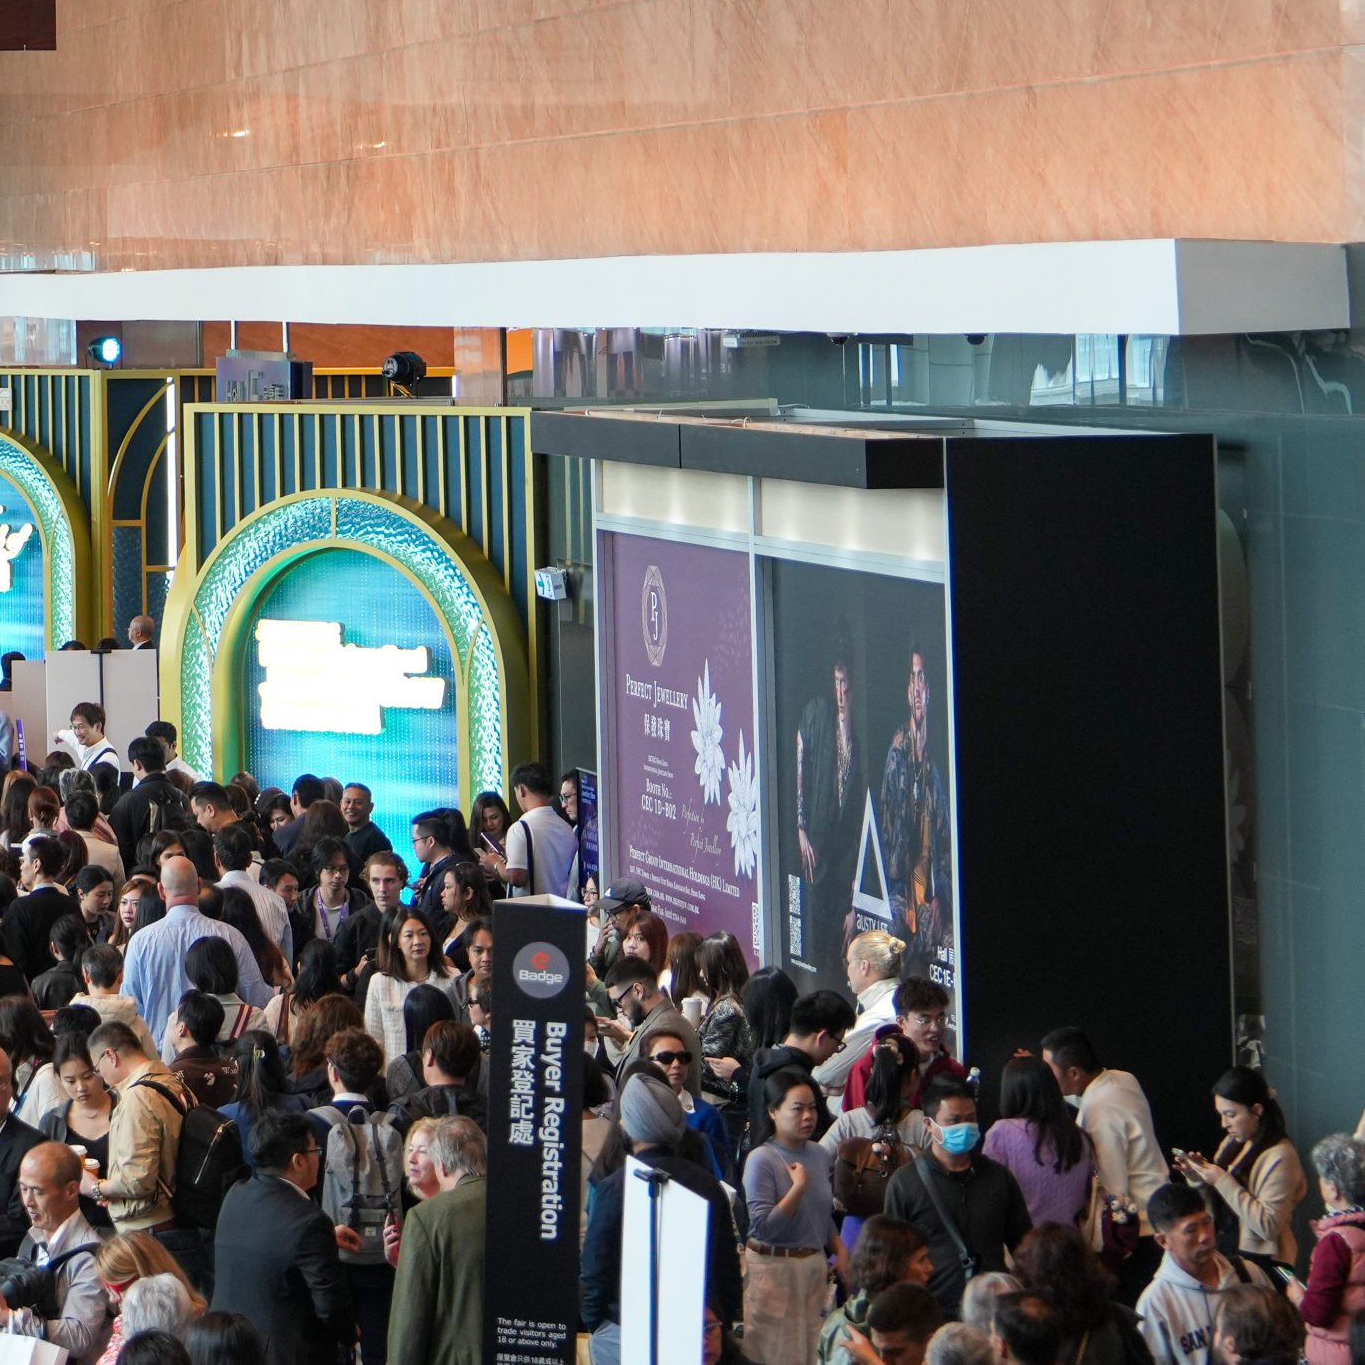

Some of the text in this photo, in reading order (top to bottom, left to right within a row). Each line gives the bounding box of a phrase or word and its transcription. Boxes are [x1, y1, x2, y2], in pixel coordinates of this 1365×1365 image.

[641, 794, 677, 820] CEC 1D-B02
[519, 969, 563, 984] Badge
[509, 1019, 537, 1147] 買家登記處
[541, 1021, 567, 1240] Buyer Registration
[497, 1317, 512, 1326] The
[514, 1318, 527, 1327] fair
[497, 1326, 566, 1340] trade visitors aged
[517, 1338, 539, 1346] above
[540, 1340, 558, 1349] only.
